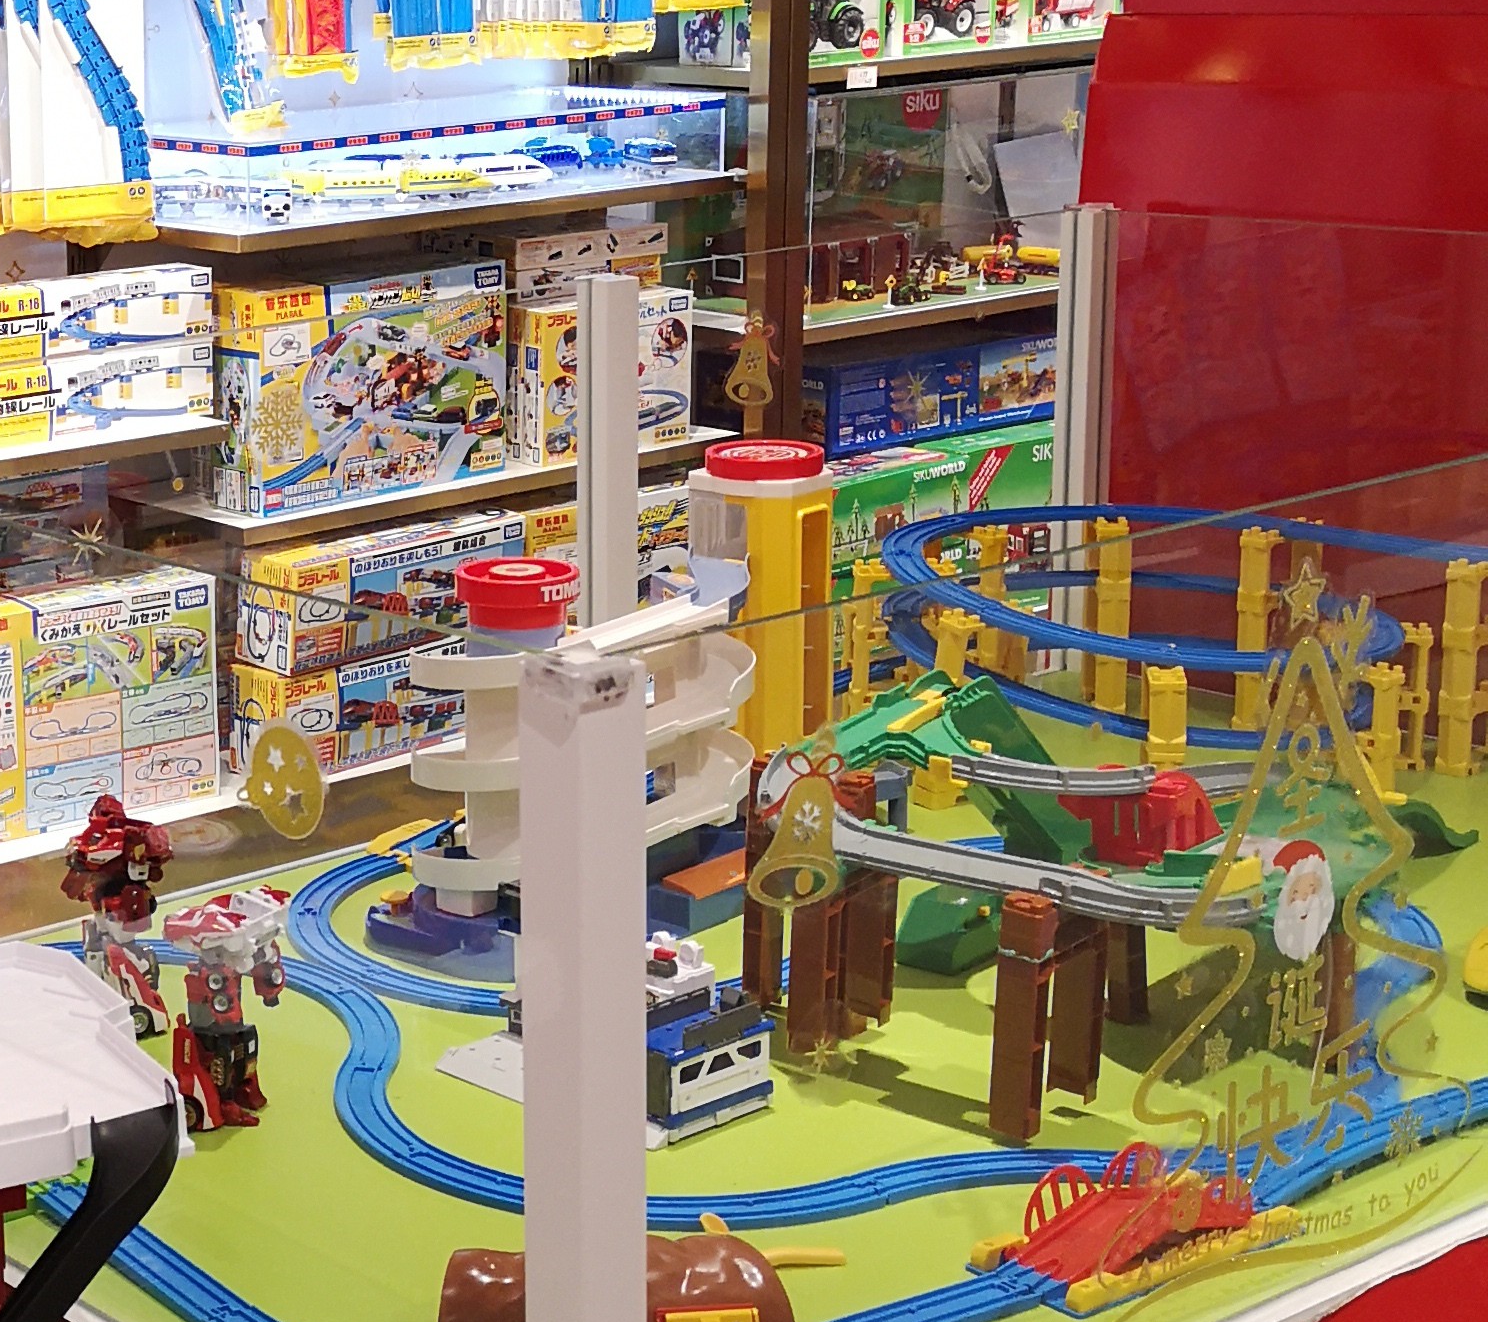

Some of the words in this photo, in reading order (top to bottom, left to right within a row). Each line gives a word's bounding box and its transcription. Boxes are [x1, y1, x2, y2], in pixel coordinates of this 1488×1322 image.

[905, 93, 941, 114] siku
[18, 297, 40, 312] R-18
[25, 374, 47, 389] R-18
[913, 460, 966, 484] SIKUWORLD
[297, 569, 340, 588] プラレール
[177, 596, 208, 609] TOMY
